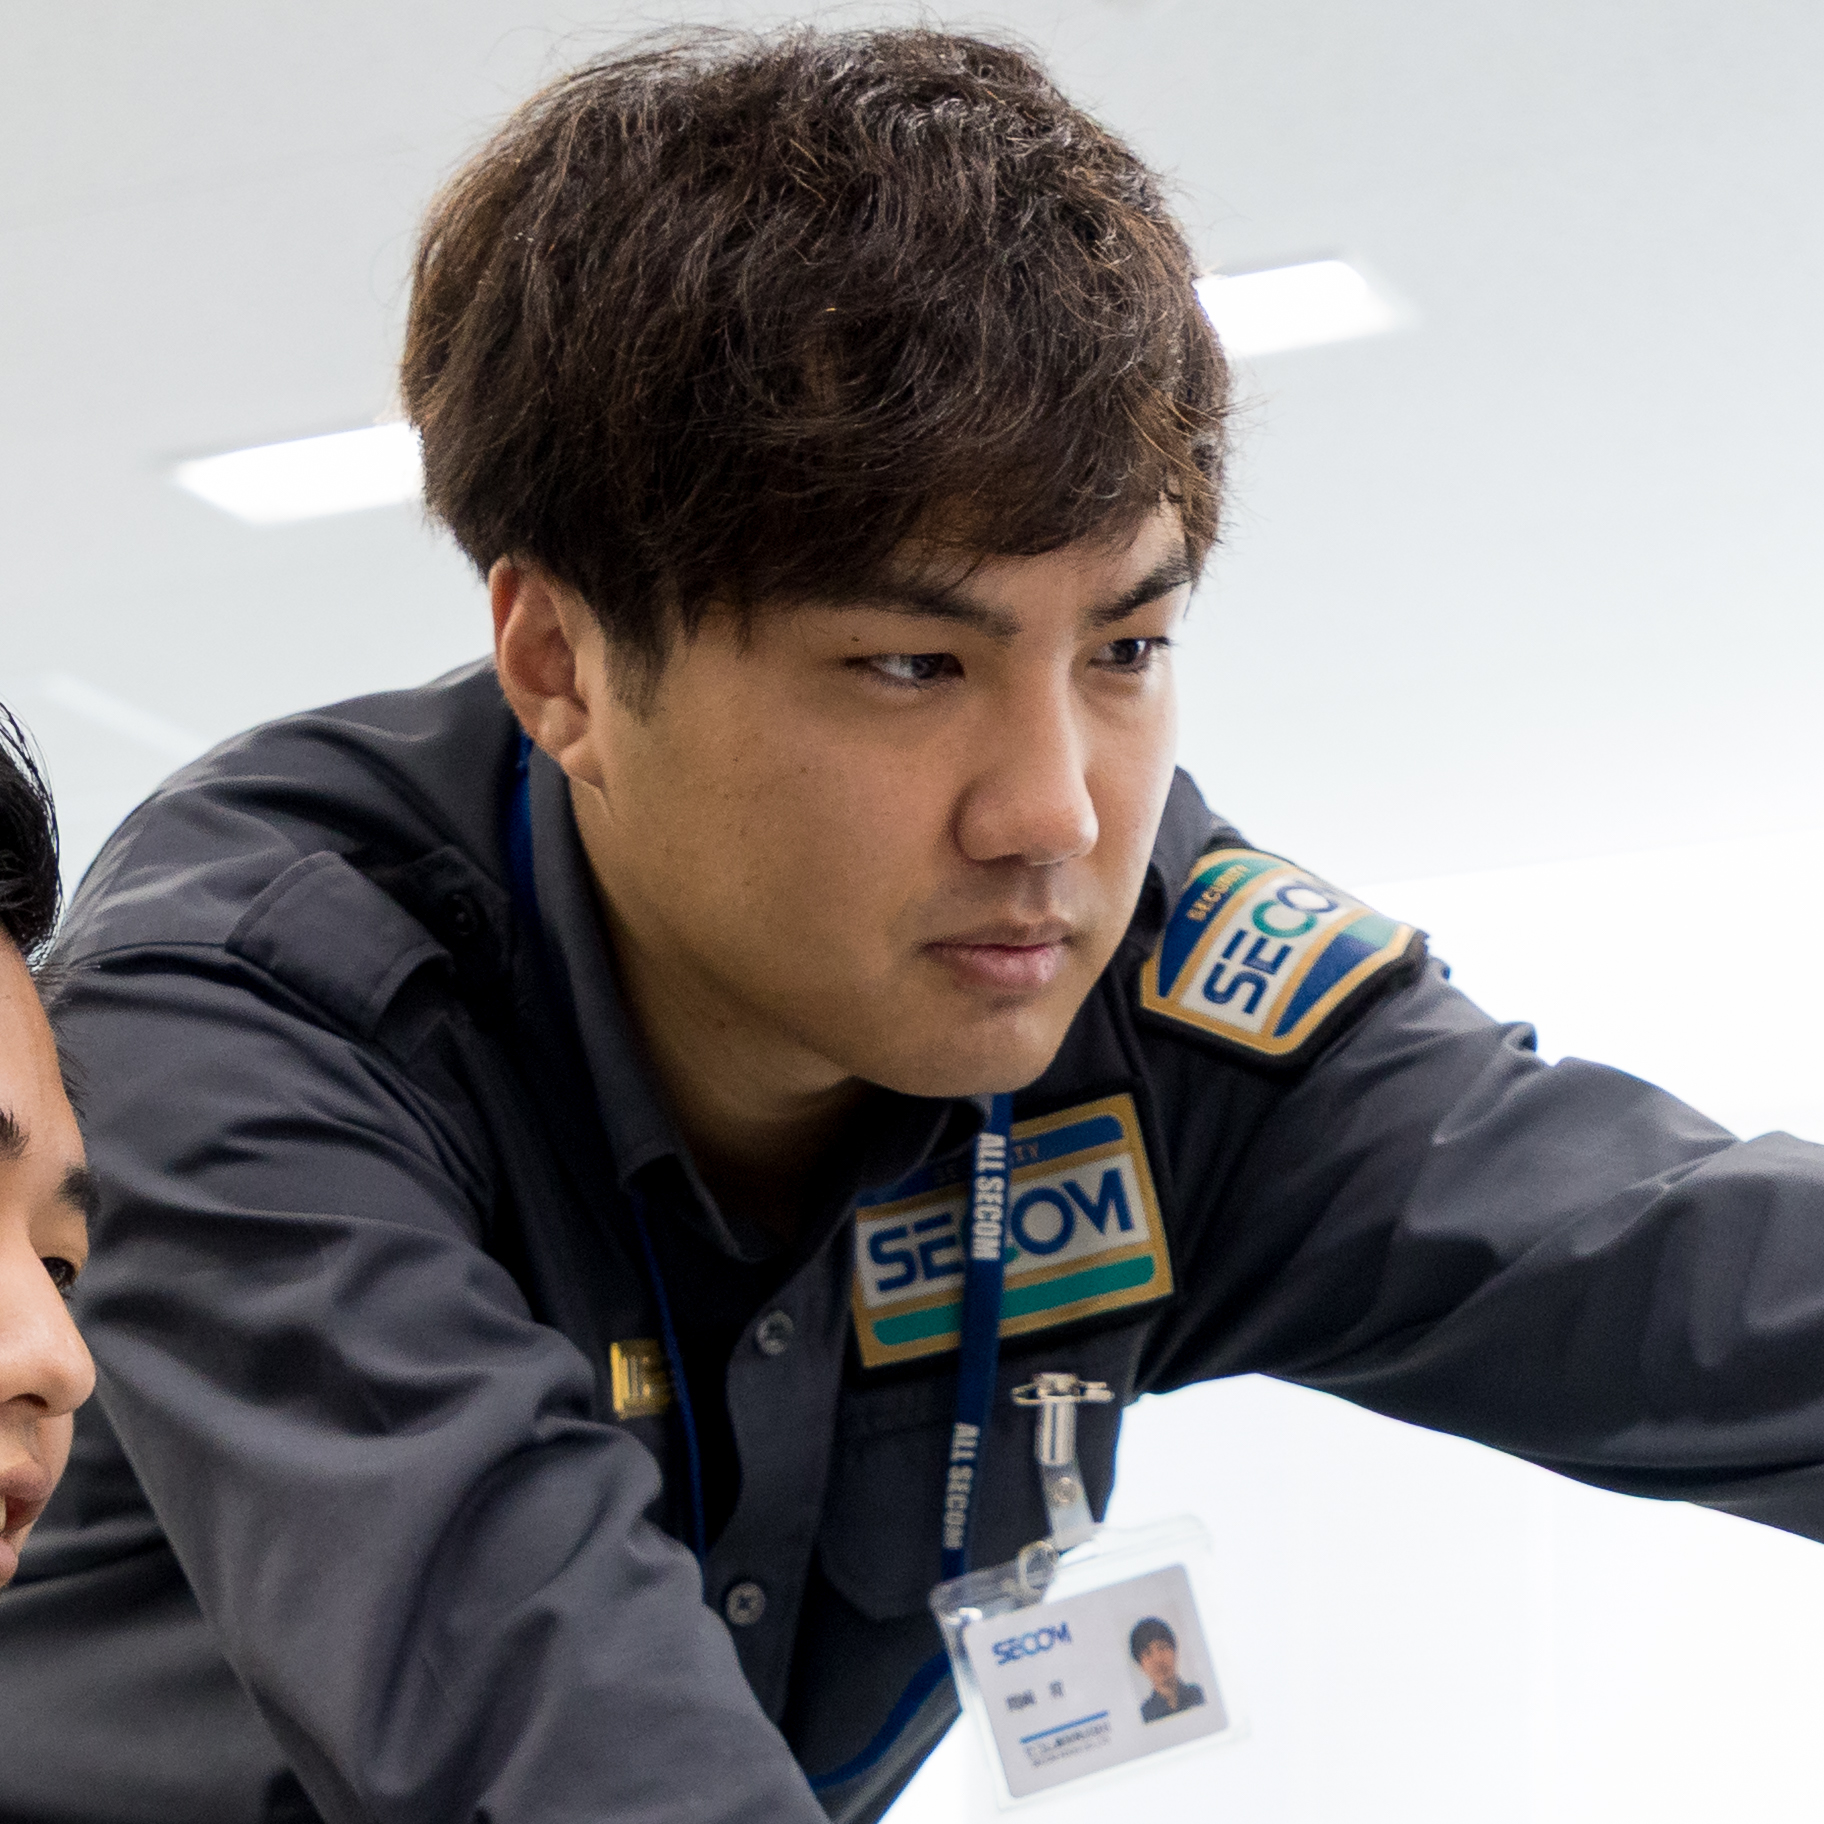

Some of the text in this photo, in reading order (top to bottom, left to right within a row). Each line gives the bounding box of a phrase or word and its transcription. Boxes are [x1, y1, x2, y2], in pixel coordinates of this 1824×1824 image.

[1202, 882, 1339, 1015] SECO
[867, 1167, 1134, 1293] SEOM
[971, 1131, 1007, 1261] ALL SECOM
[942, 1463, 975, 1550] SECOM
